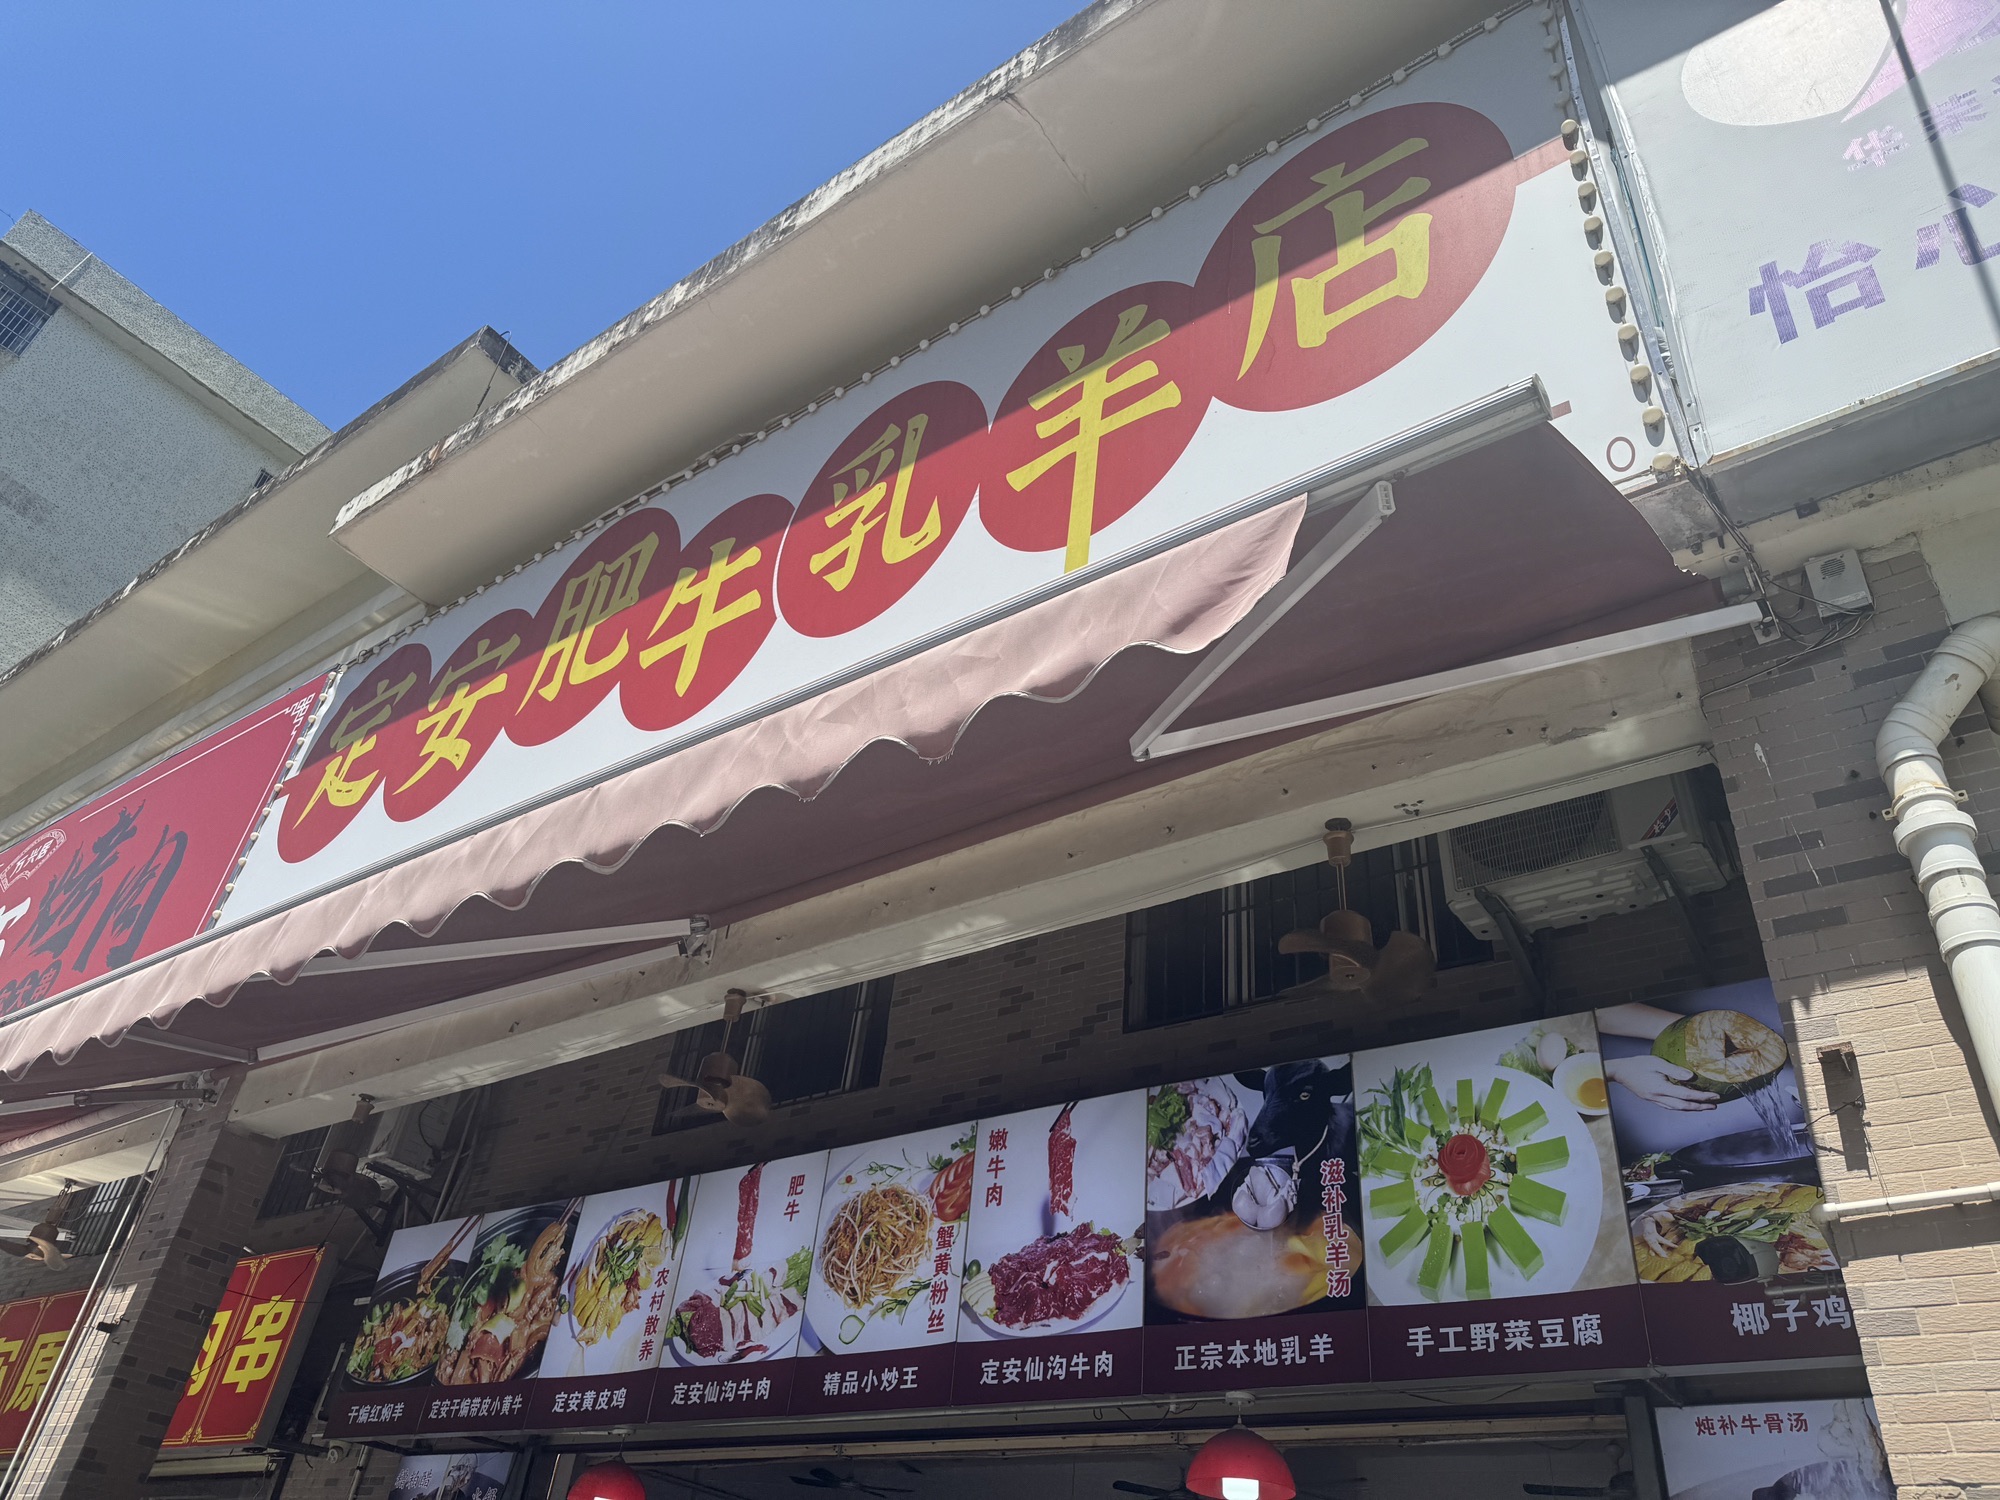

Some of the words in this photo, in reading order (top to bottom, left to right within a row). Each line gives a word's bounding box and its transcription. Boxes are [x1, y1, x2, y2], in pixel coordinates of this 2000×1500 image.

[292, 137, 1433, 830] 定安肥牛乳羊店
[985, 1127, 1009, 1208] 嫩牛肉
[783, 1173, 806, 1222] 肥牛
[1320, 1158, 1352, 1299] 滋补乳羊汤
[926, 1224, 955, 1334] 蟹黄粉丝
[638, 1267, 669, 1361] 农村散养
[1406, 1313, 1604, 1357] 手工野菜豆腐
[1730, 1294, 1853, 1338] 椰子鸡
[979, 1350, 1115, 1386] 定安仙沟牛肉
[1173, 1333, 1335, 1373] 正宗本地乳羊
[551, 1387, 628, 1413] 定安黄皮鸡
[671, 1377, 772, 1405] 定安仙沟牛肉
[822, 1365, 920, 1396] 精品小炒王
[1695, 1412, 1810, 1437] 炖补牛骨汤
